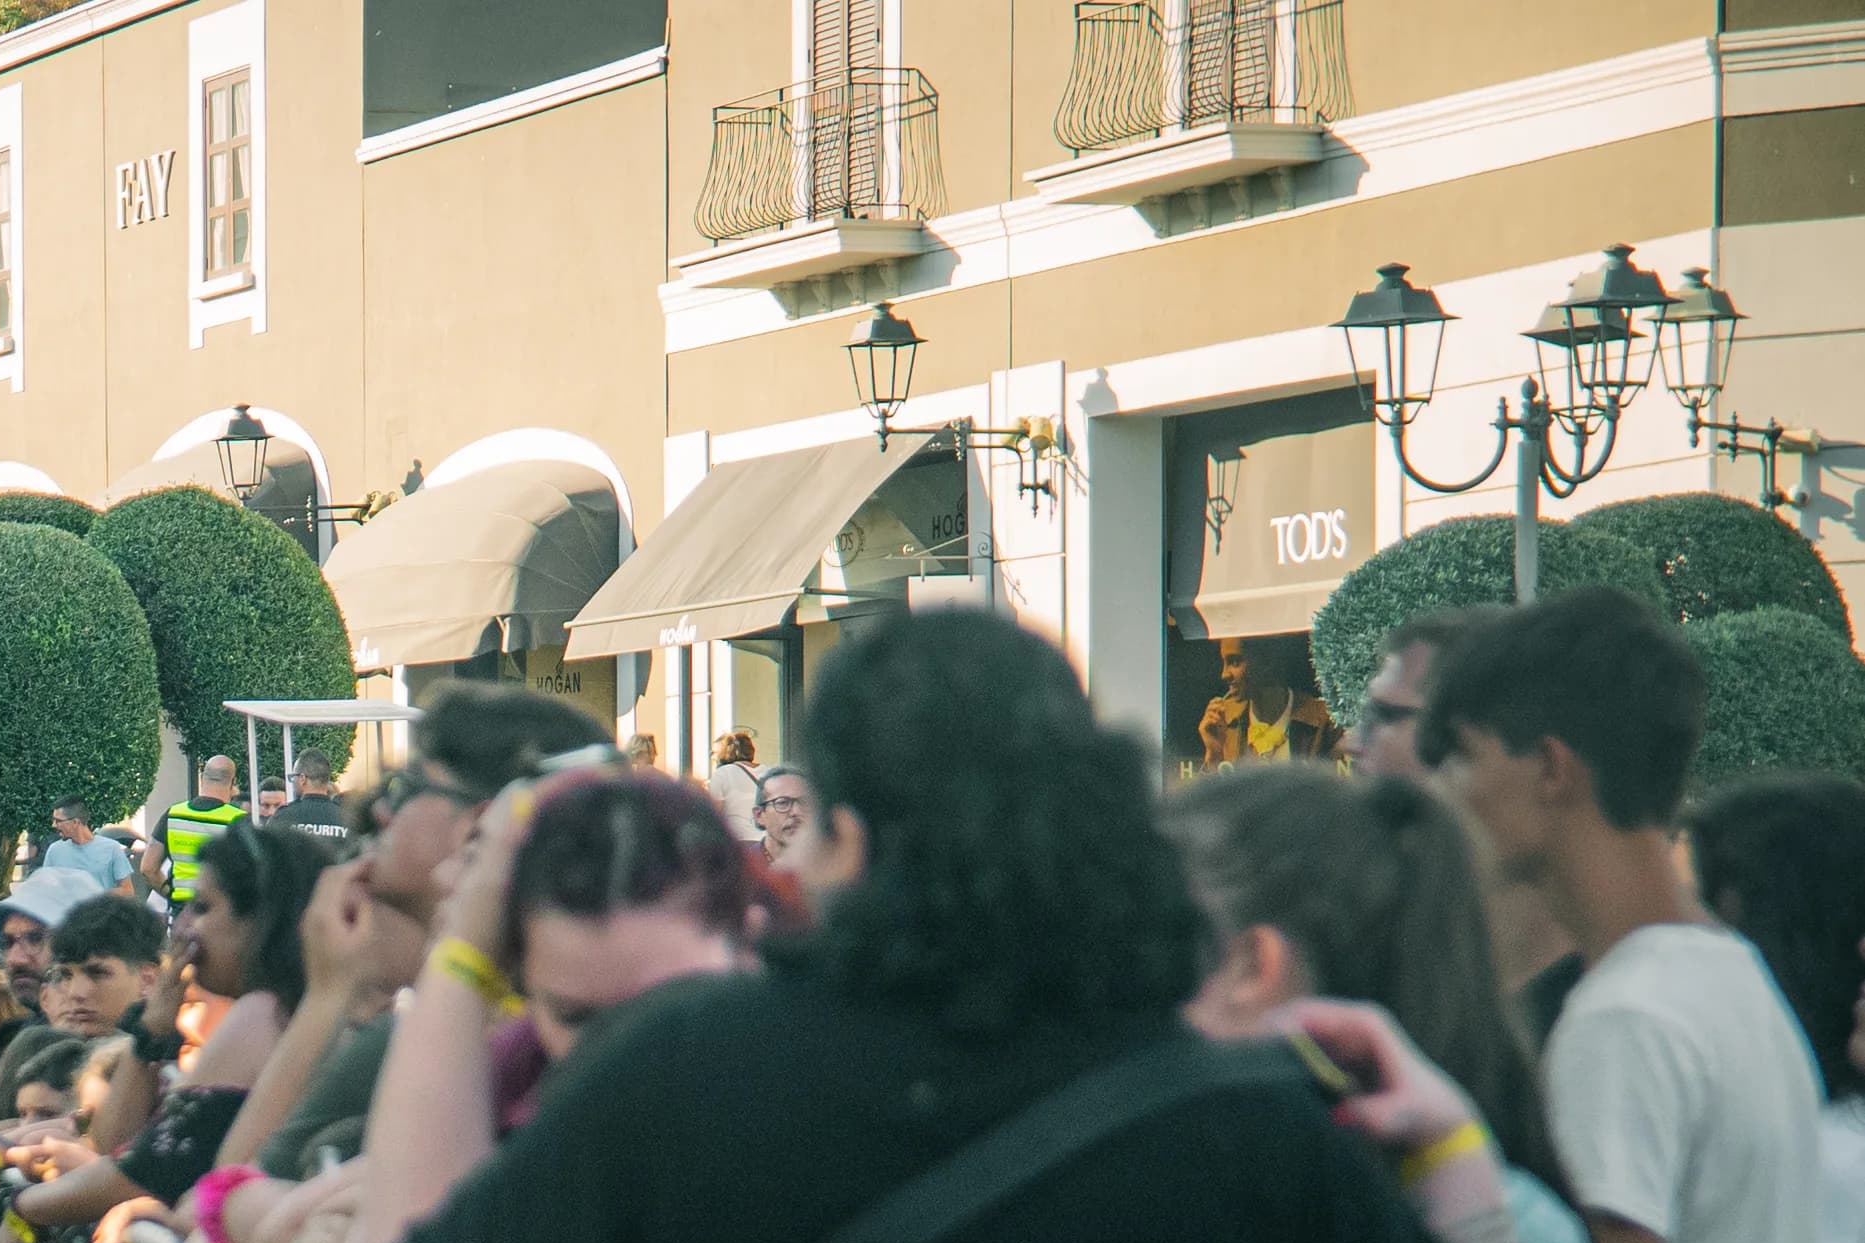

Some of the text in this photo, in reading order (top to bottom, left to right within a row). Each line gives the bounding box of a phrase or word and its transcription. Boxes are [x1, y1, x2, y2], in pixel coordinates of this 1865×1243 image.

[115, 148, 177, 229] FAY
[932, 513, 966, 540] HOG
[1270, 508, 1347, 565] TOD'S
[536, 671, 582, 694] HOGAN
